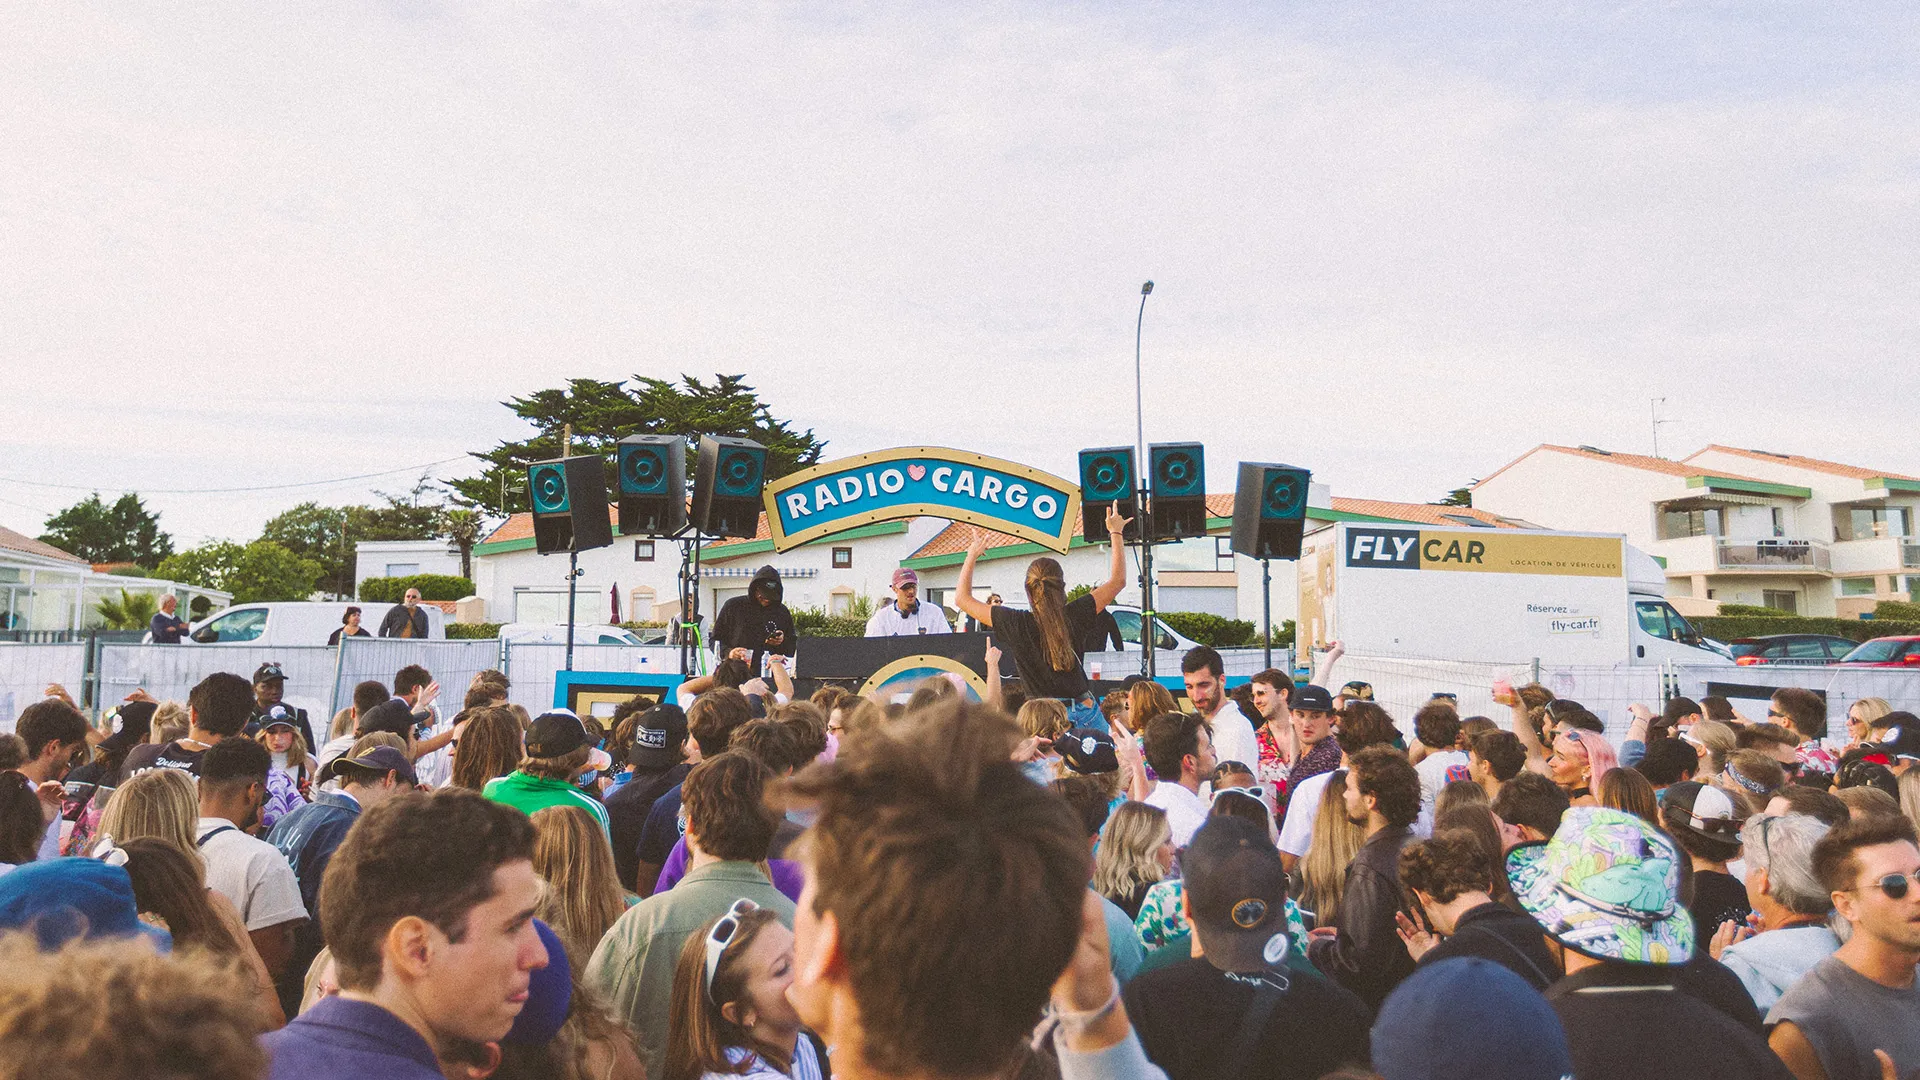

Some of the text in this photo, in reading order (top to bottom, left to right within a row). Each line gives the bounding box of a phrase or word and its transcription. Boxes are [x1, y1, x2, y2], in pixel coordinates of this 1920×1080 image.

[785, 467, 1058, 520] RADIO CARGO
[1352, 536, 1486, 564] FLY CAR
[1526, 604, 1568, 614] Réservez
[1551, 618, 1598, 632] fly-car.fr
